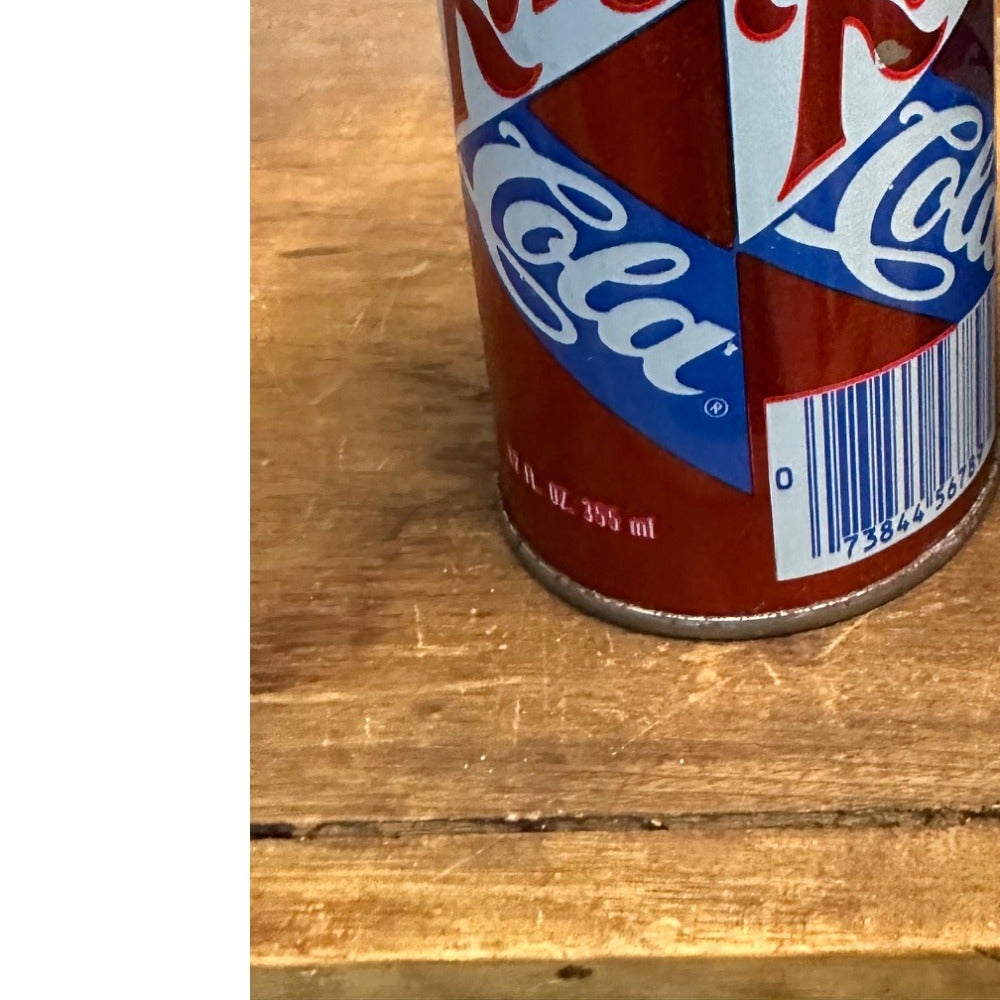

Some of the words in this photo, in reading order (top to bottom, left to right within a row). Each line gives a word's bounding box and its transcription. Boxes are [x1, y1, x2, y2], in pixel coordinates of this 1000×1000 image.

[458, 121, 736, 395] Cola
[775, 466, 794, 490] 0
[628, 517, 656, 540] ml
